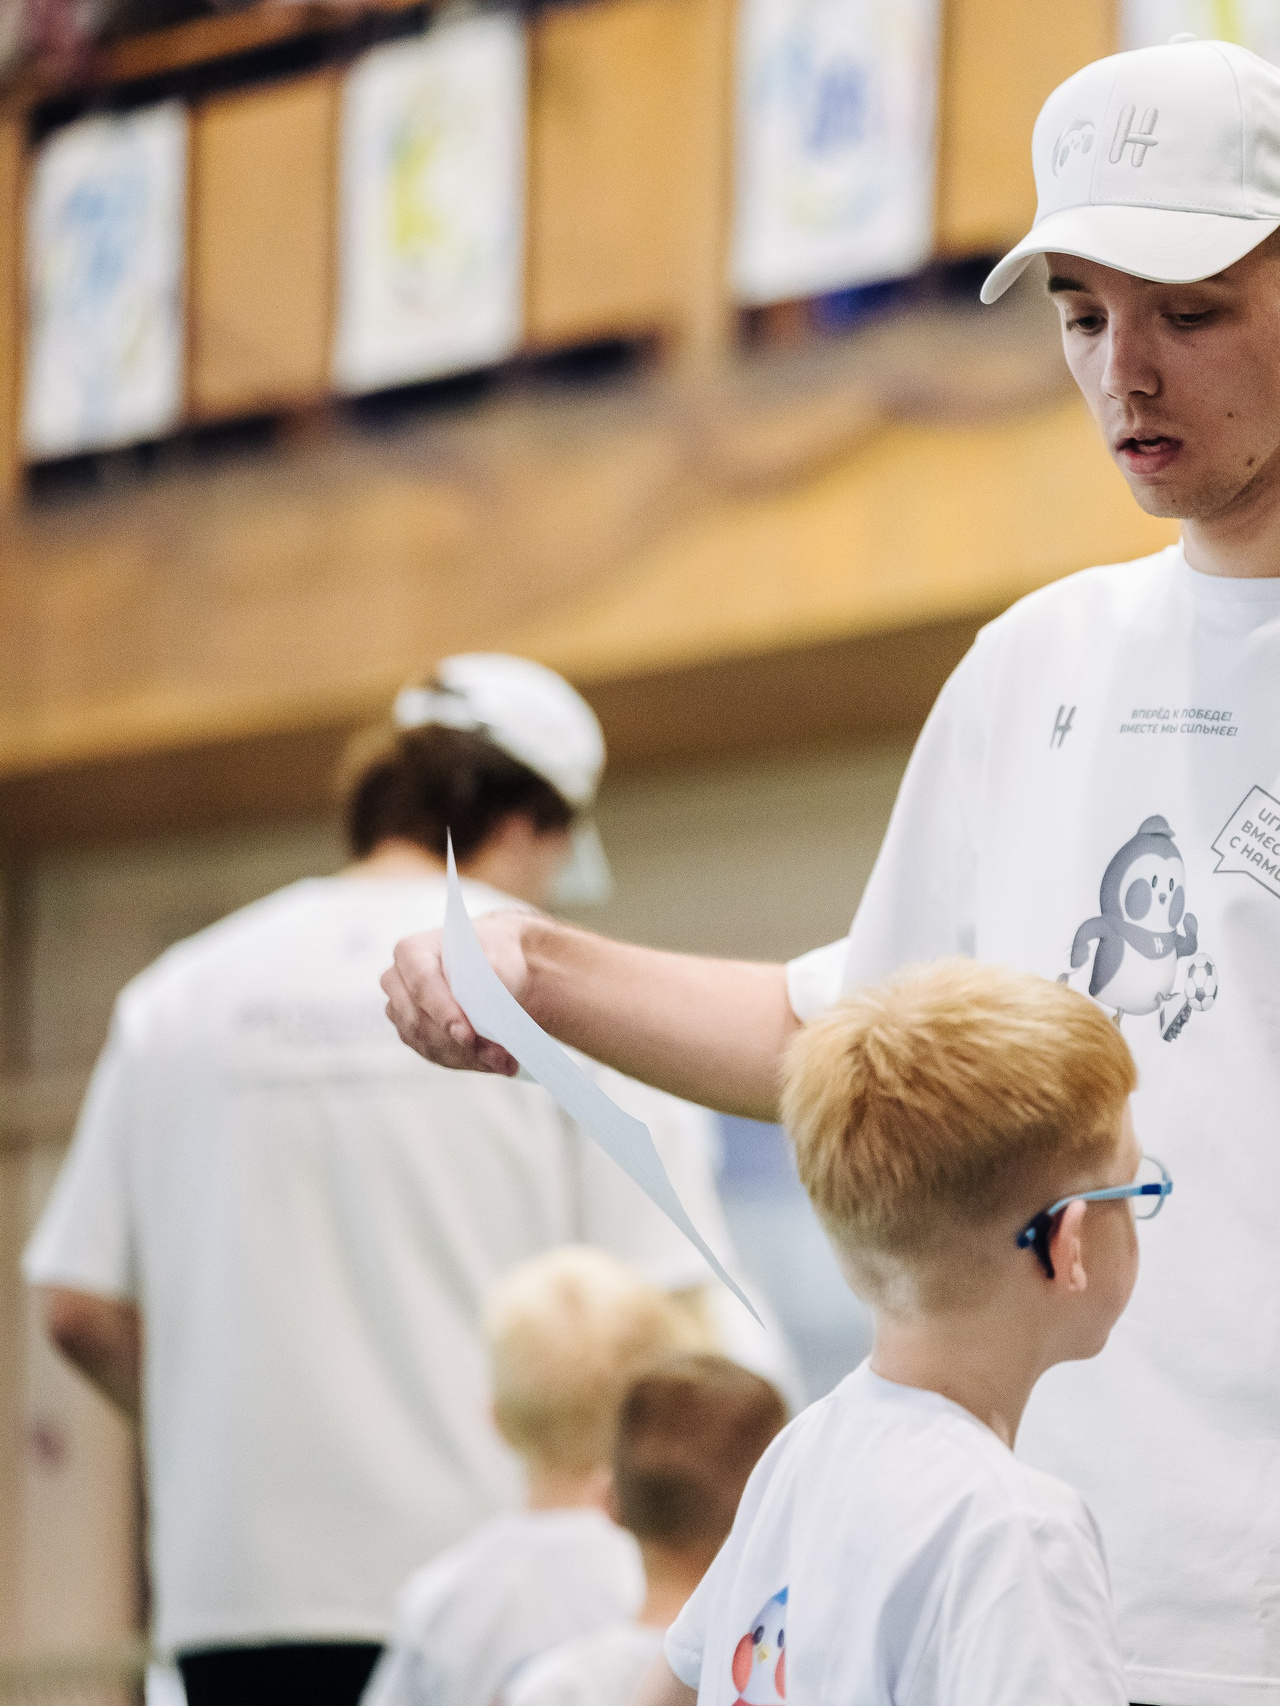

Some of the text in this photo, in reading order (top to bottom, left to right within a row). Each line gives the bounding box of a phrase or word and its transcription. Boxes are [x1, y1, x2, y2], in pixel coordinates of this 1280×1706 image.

[1181, 708, 1233, 722] ПОБЕДЕ!
[1119, 723, 1239, 737] ВМЕСТЕ МЫ СИЛЬНЕЕ!
